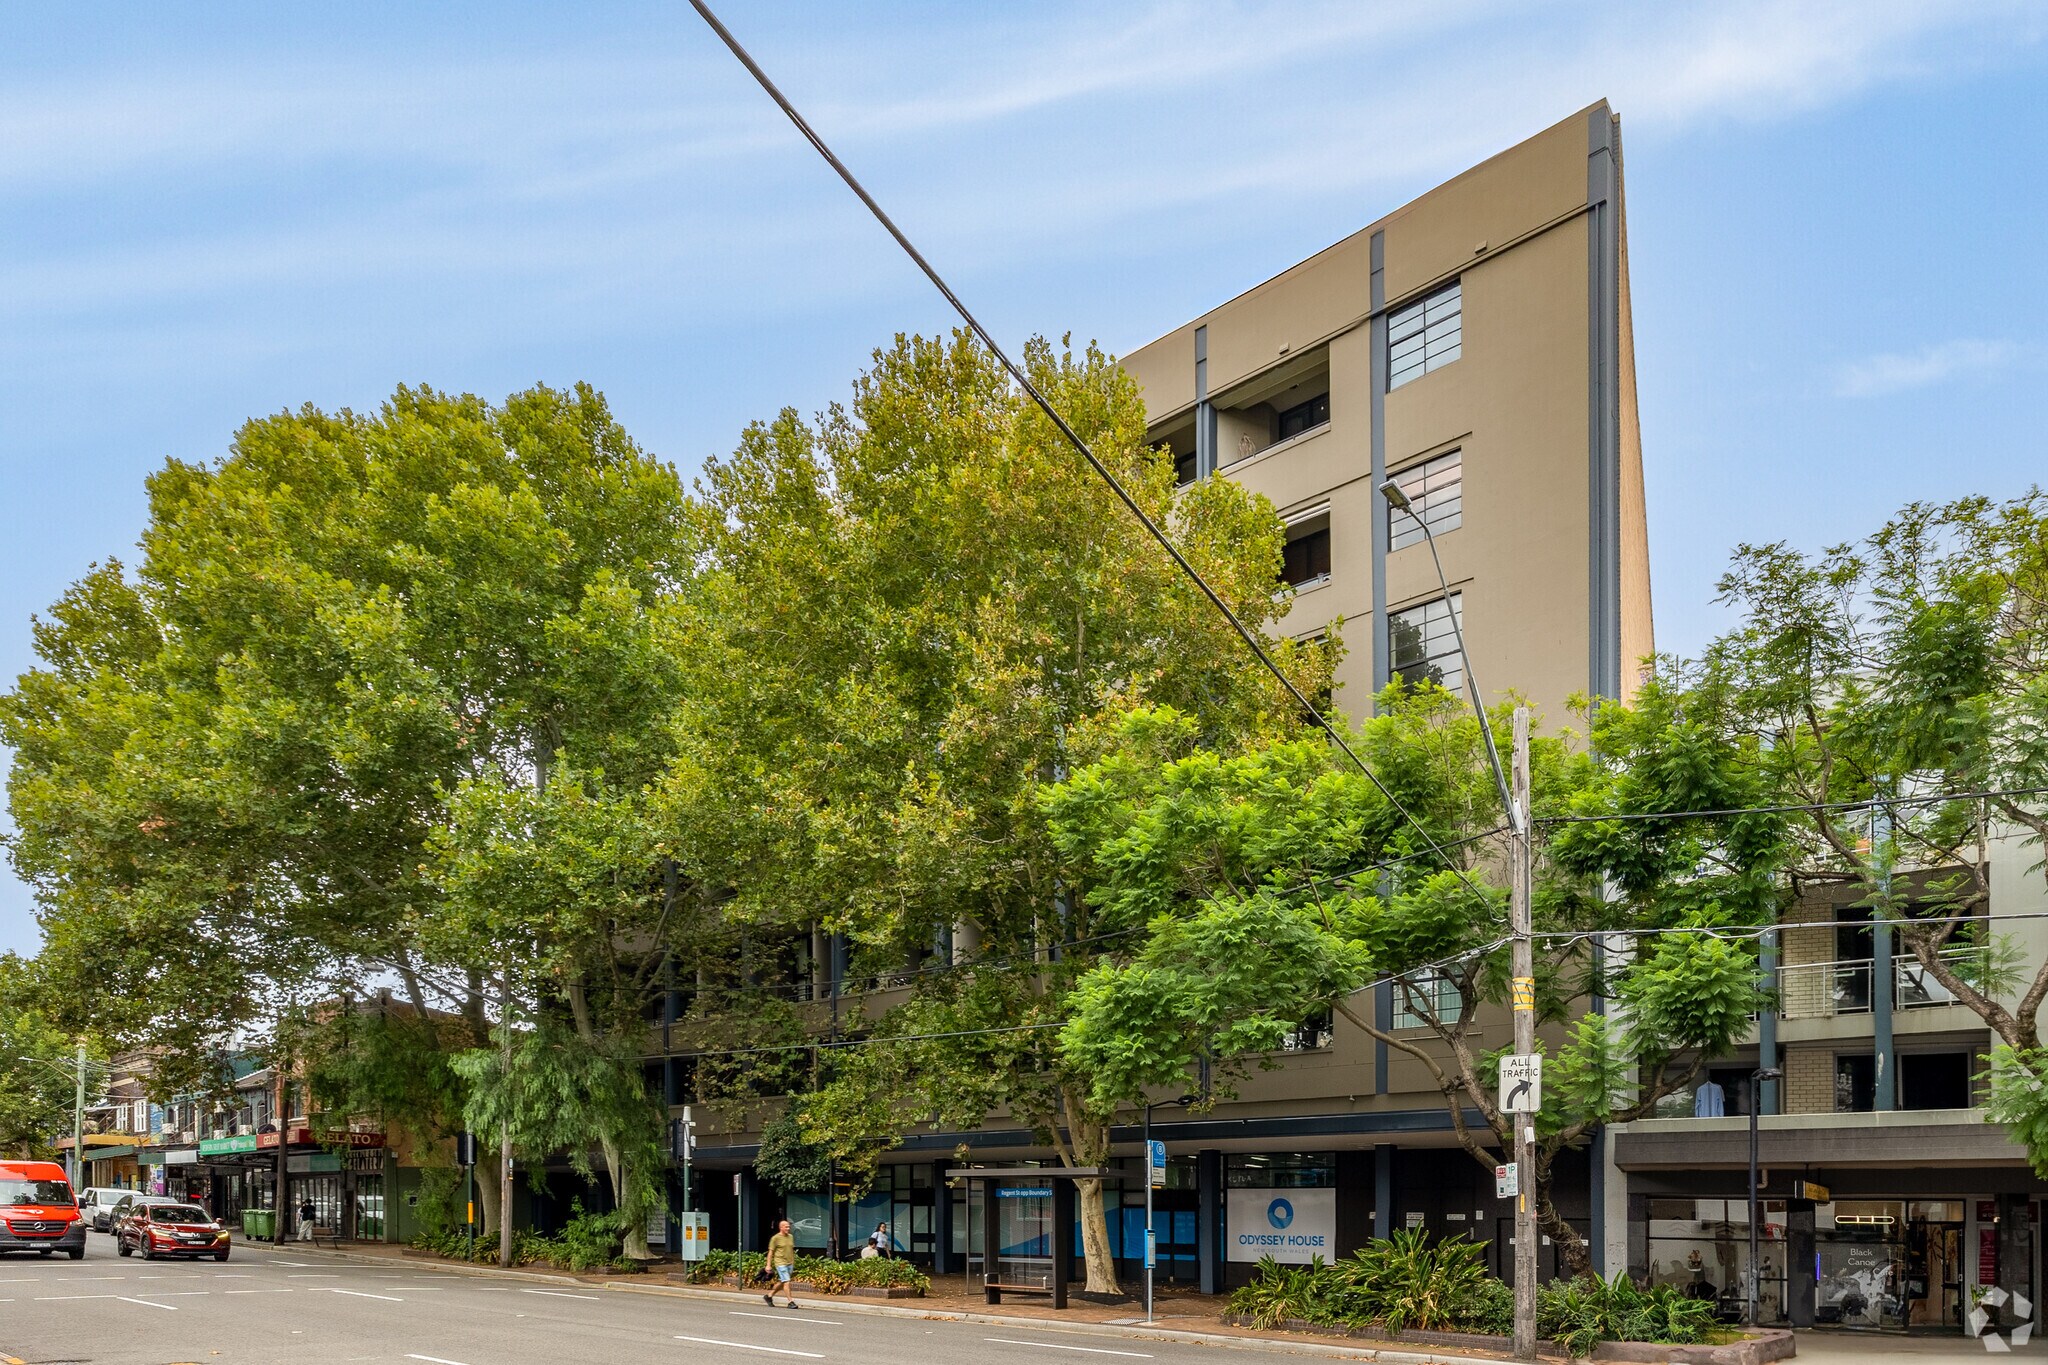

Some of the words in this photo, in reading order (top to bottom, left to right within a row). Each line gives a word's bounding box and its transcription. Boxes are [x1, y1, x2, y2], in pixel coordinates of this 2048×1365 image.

[1510, 1058, 1530, 1067] ALL
[1502, 1067, 1538, 1078] TRAFFIC
[317, 1132, 371, 1145] GELATO
[1239, 1234, 1285, 1246] ODYSSEY
[1288, 1235, 1325, 1246] HOUSE
[1850, 1248, 1873, 1256] Black
[1847, 1257, 1876, 1266] Canoe
